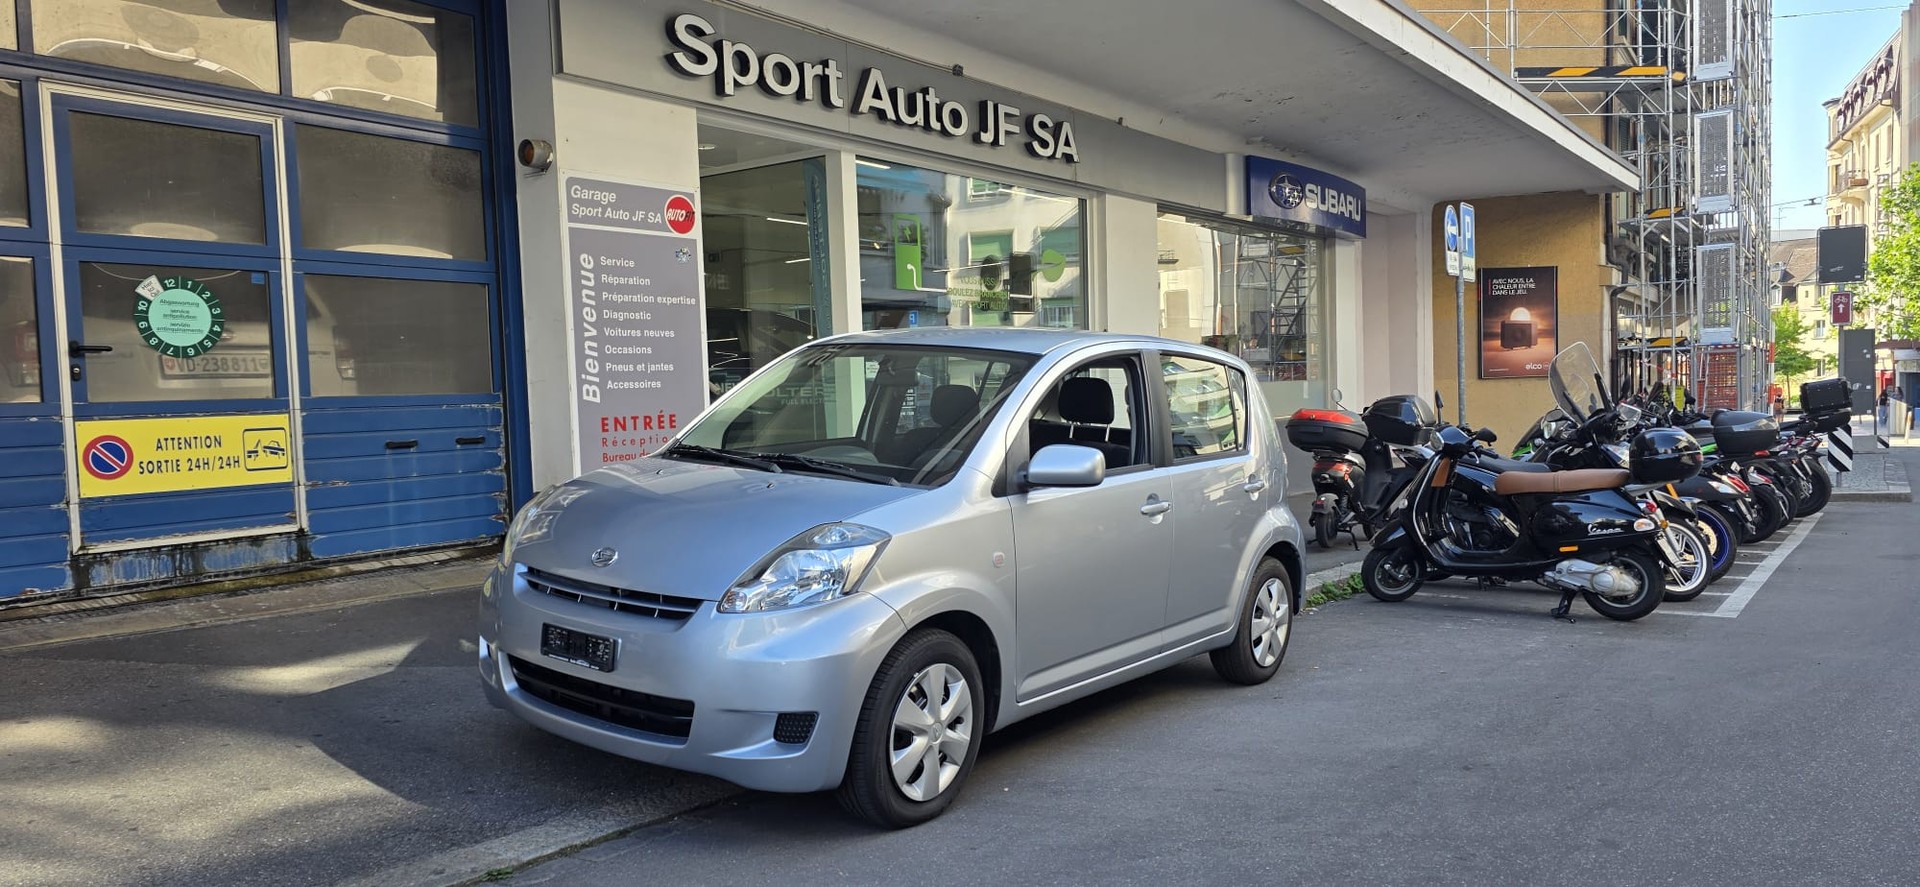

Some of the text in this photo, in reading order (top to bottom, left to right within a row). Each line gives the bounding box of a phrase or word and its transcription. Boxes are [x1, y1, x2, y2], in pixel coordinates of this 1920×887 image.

[666, 13, 1080, 163] Sport Auto JF SA
[571, 185, 617, 205] Garage
[1304, 183, 1361, 222] SUBARU
[571, 203, 662, 224] Sport Auto JF SA
[1465, 215, 1472, 252] P
[600, 256, 635, 268] Service
[164, 278, 176, 288] 12
[186, 281, 193, 289] 1
[601, 273, 651, 286] Réparation
[201, 291, 211, 300] 2
[602, 291, 696, 306] Préparation expertise
[137, 300, 148, 311] 10
[211, 307, 221, 315] 3
[603, 309, 652, 322] Diagnostic
[579, 253, 601, 404] Bienvenue
[603, 326, 675, 338] Voitures neuves
[149, 337, 158, 346] 8
[203, 339, 212, 348] 5
[167, 347, 174, 355] 7
[604, 344, 652, 354] Occasions
[605, 362, 675, 374] Pneus et jantes
[606, 379, 662, 390] Accessoires
[600, 409, 677, 433] ENTRÉE
[155, 435, 222, 451] ATTENTION
[601, 433, 669, 448] Réceptio
[602, 452, 637, 463] Bureau
[138, 455, 240, 475] SORTIE 24H/24H
[1587, 523, 1624, 536] Vespa
